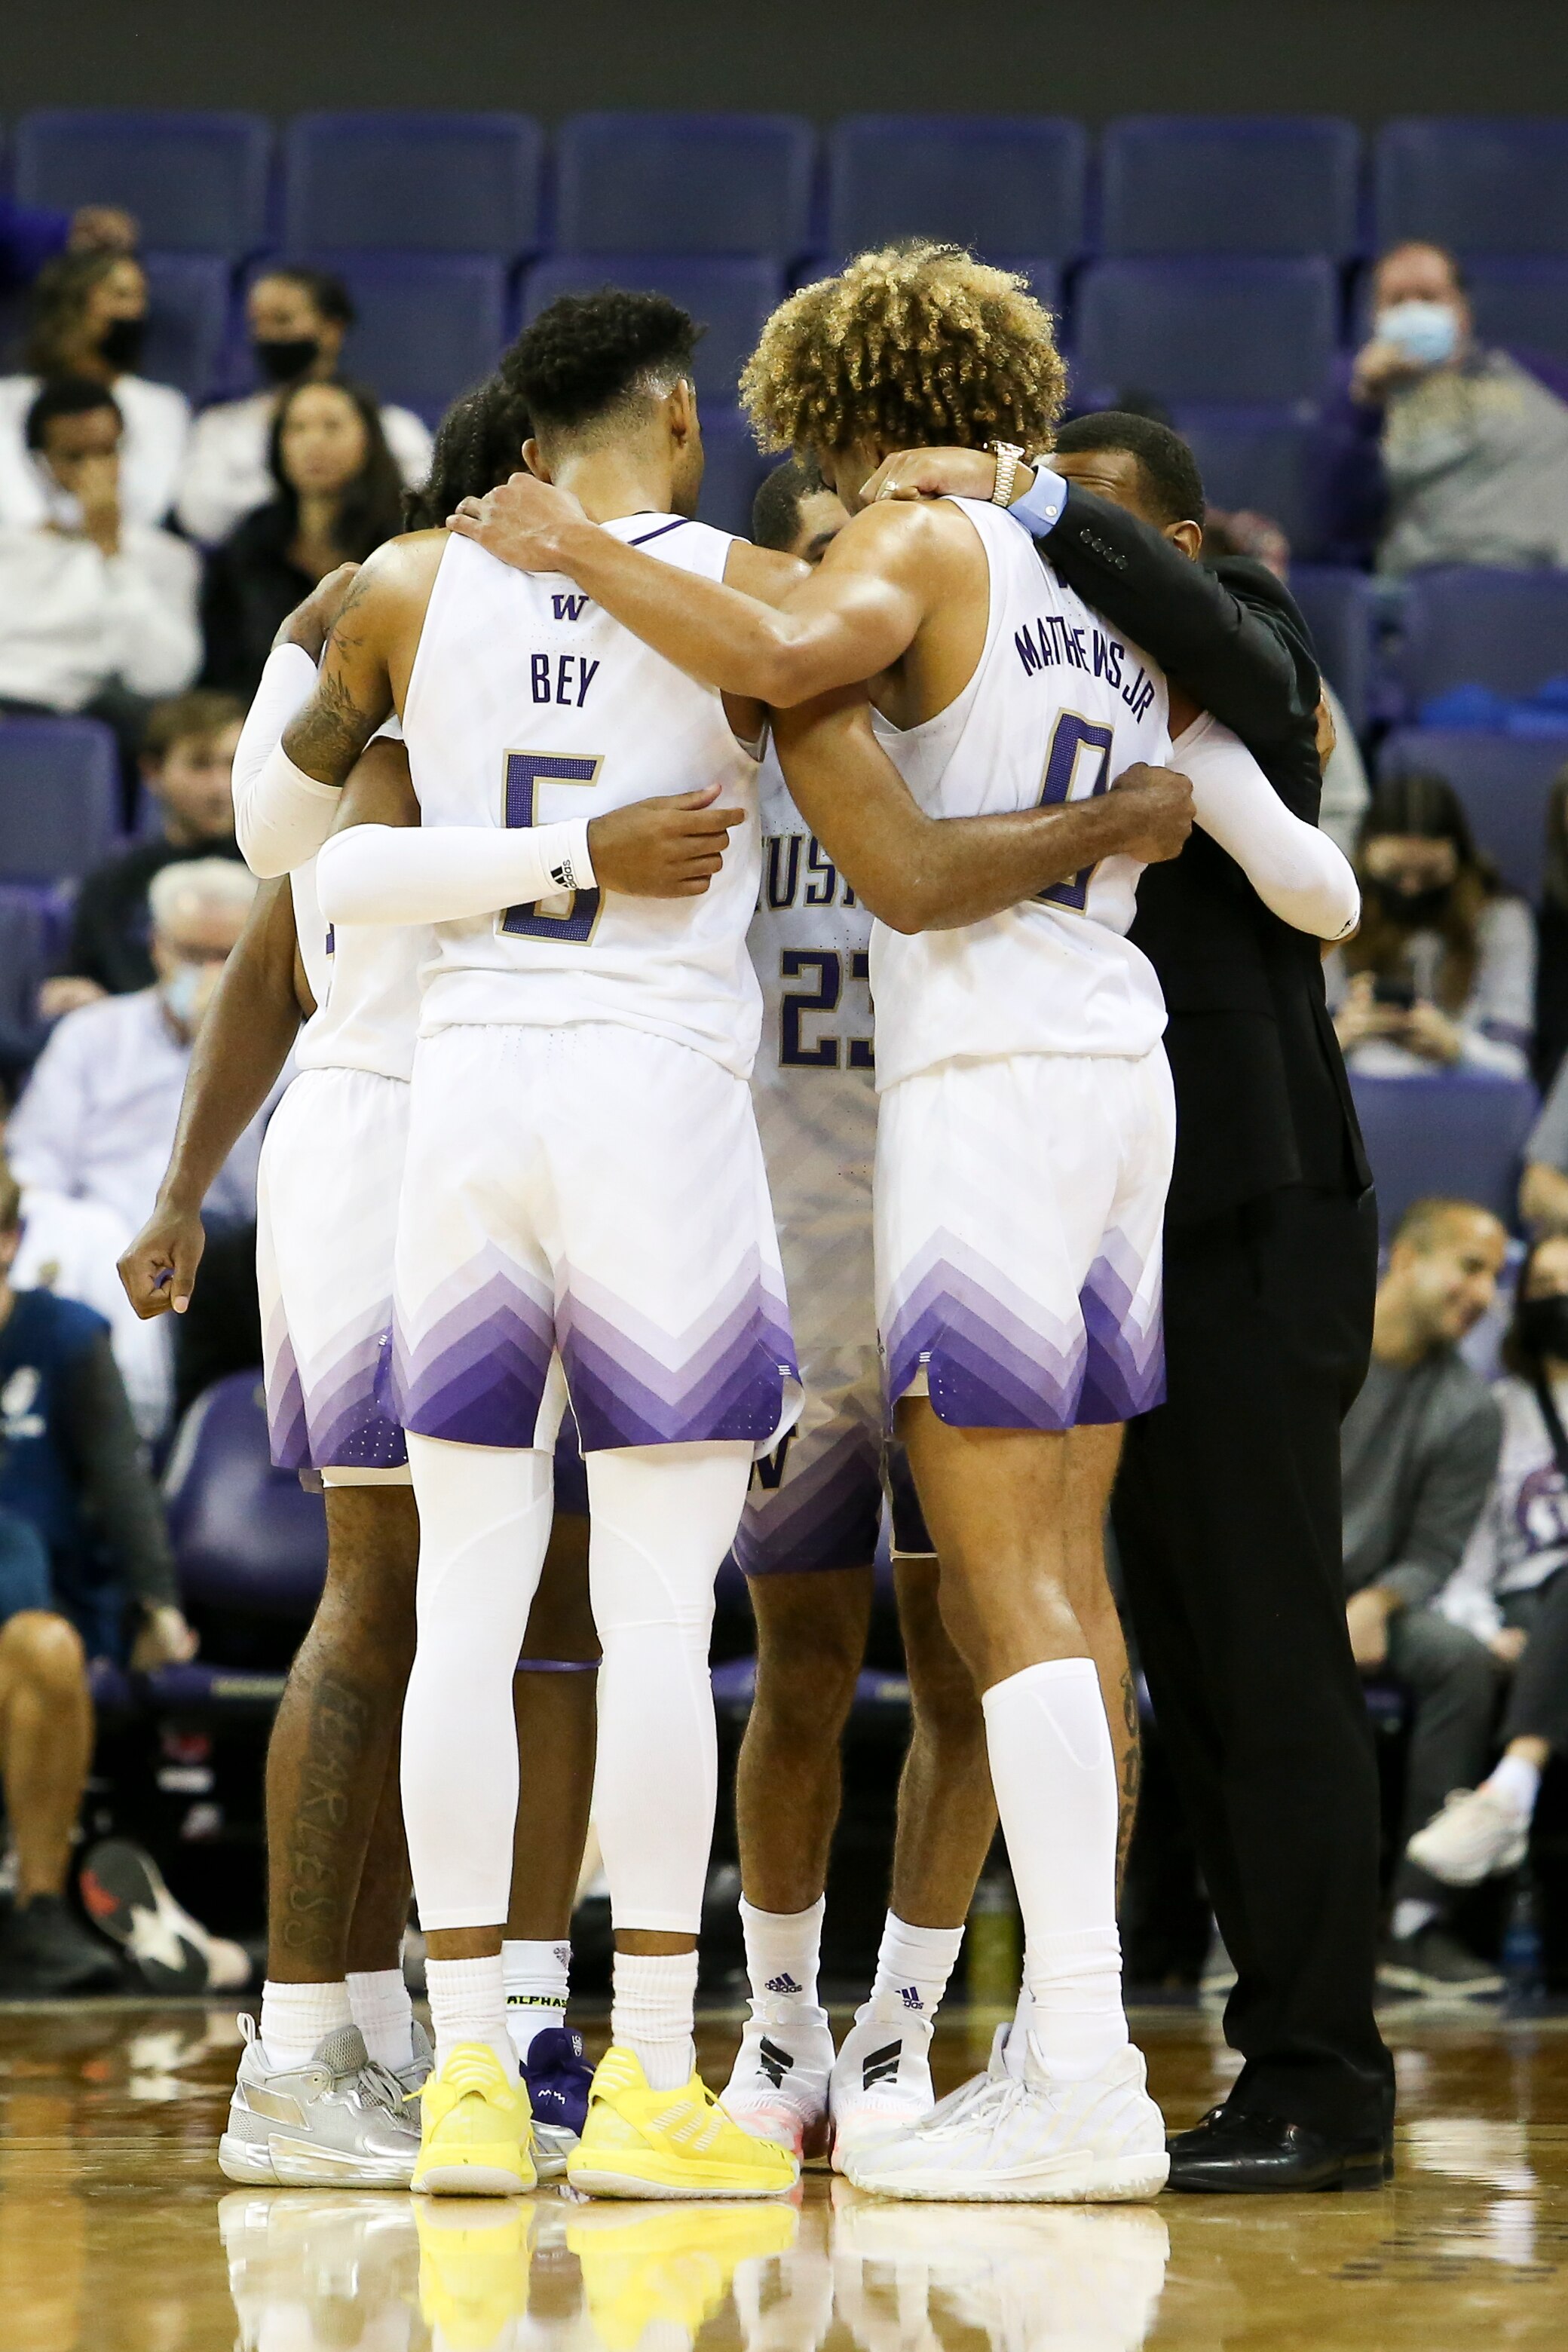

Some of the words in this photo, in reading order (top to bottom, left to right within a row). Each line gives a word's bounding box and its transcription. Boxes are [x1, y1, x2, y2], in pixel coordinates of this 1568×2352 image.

[550, 594, 590, 621] W
[531, 653, 600, 708] BEY
[1122, 666, 1155, 724] JR
[496, 749, 605, 947] 5
[756, 833, 857, 911] US
[764, 1982, 803, 1993] adidas
[902, 1998, 924, 2011] das
